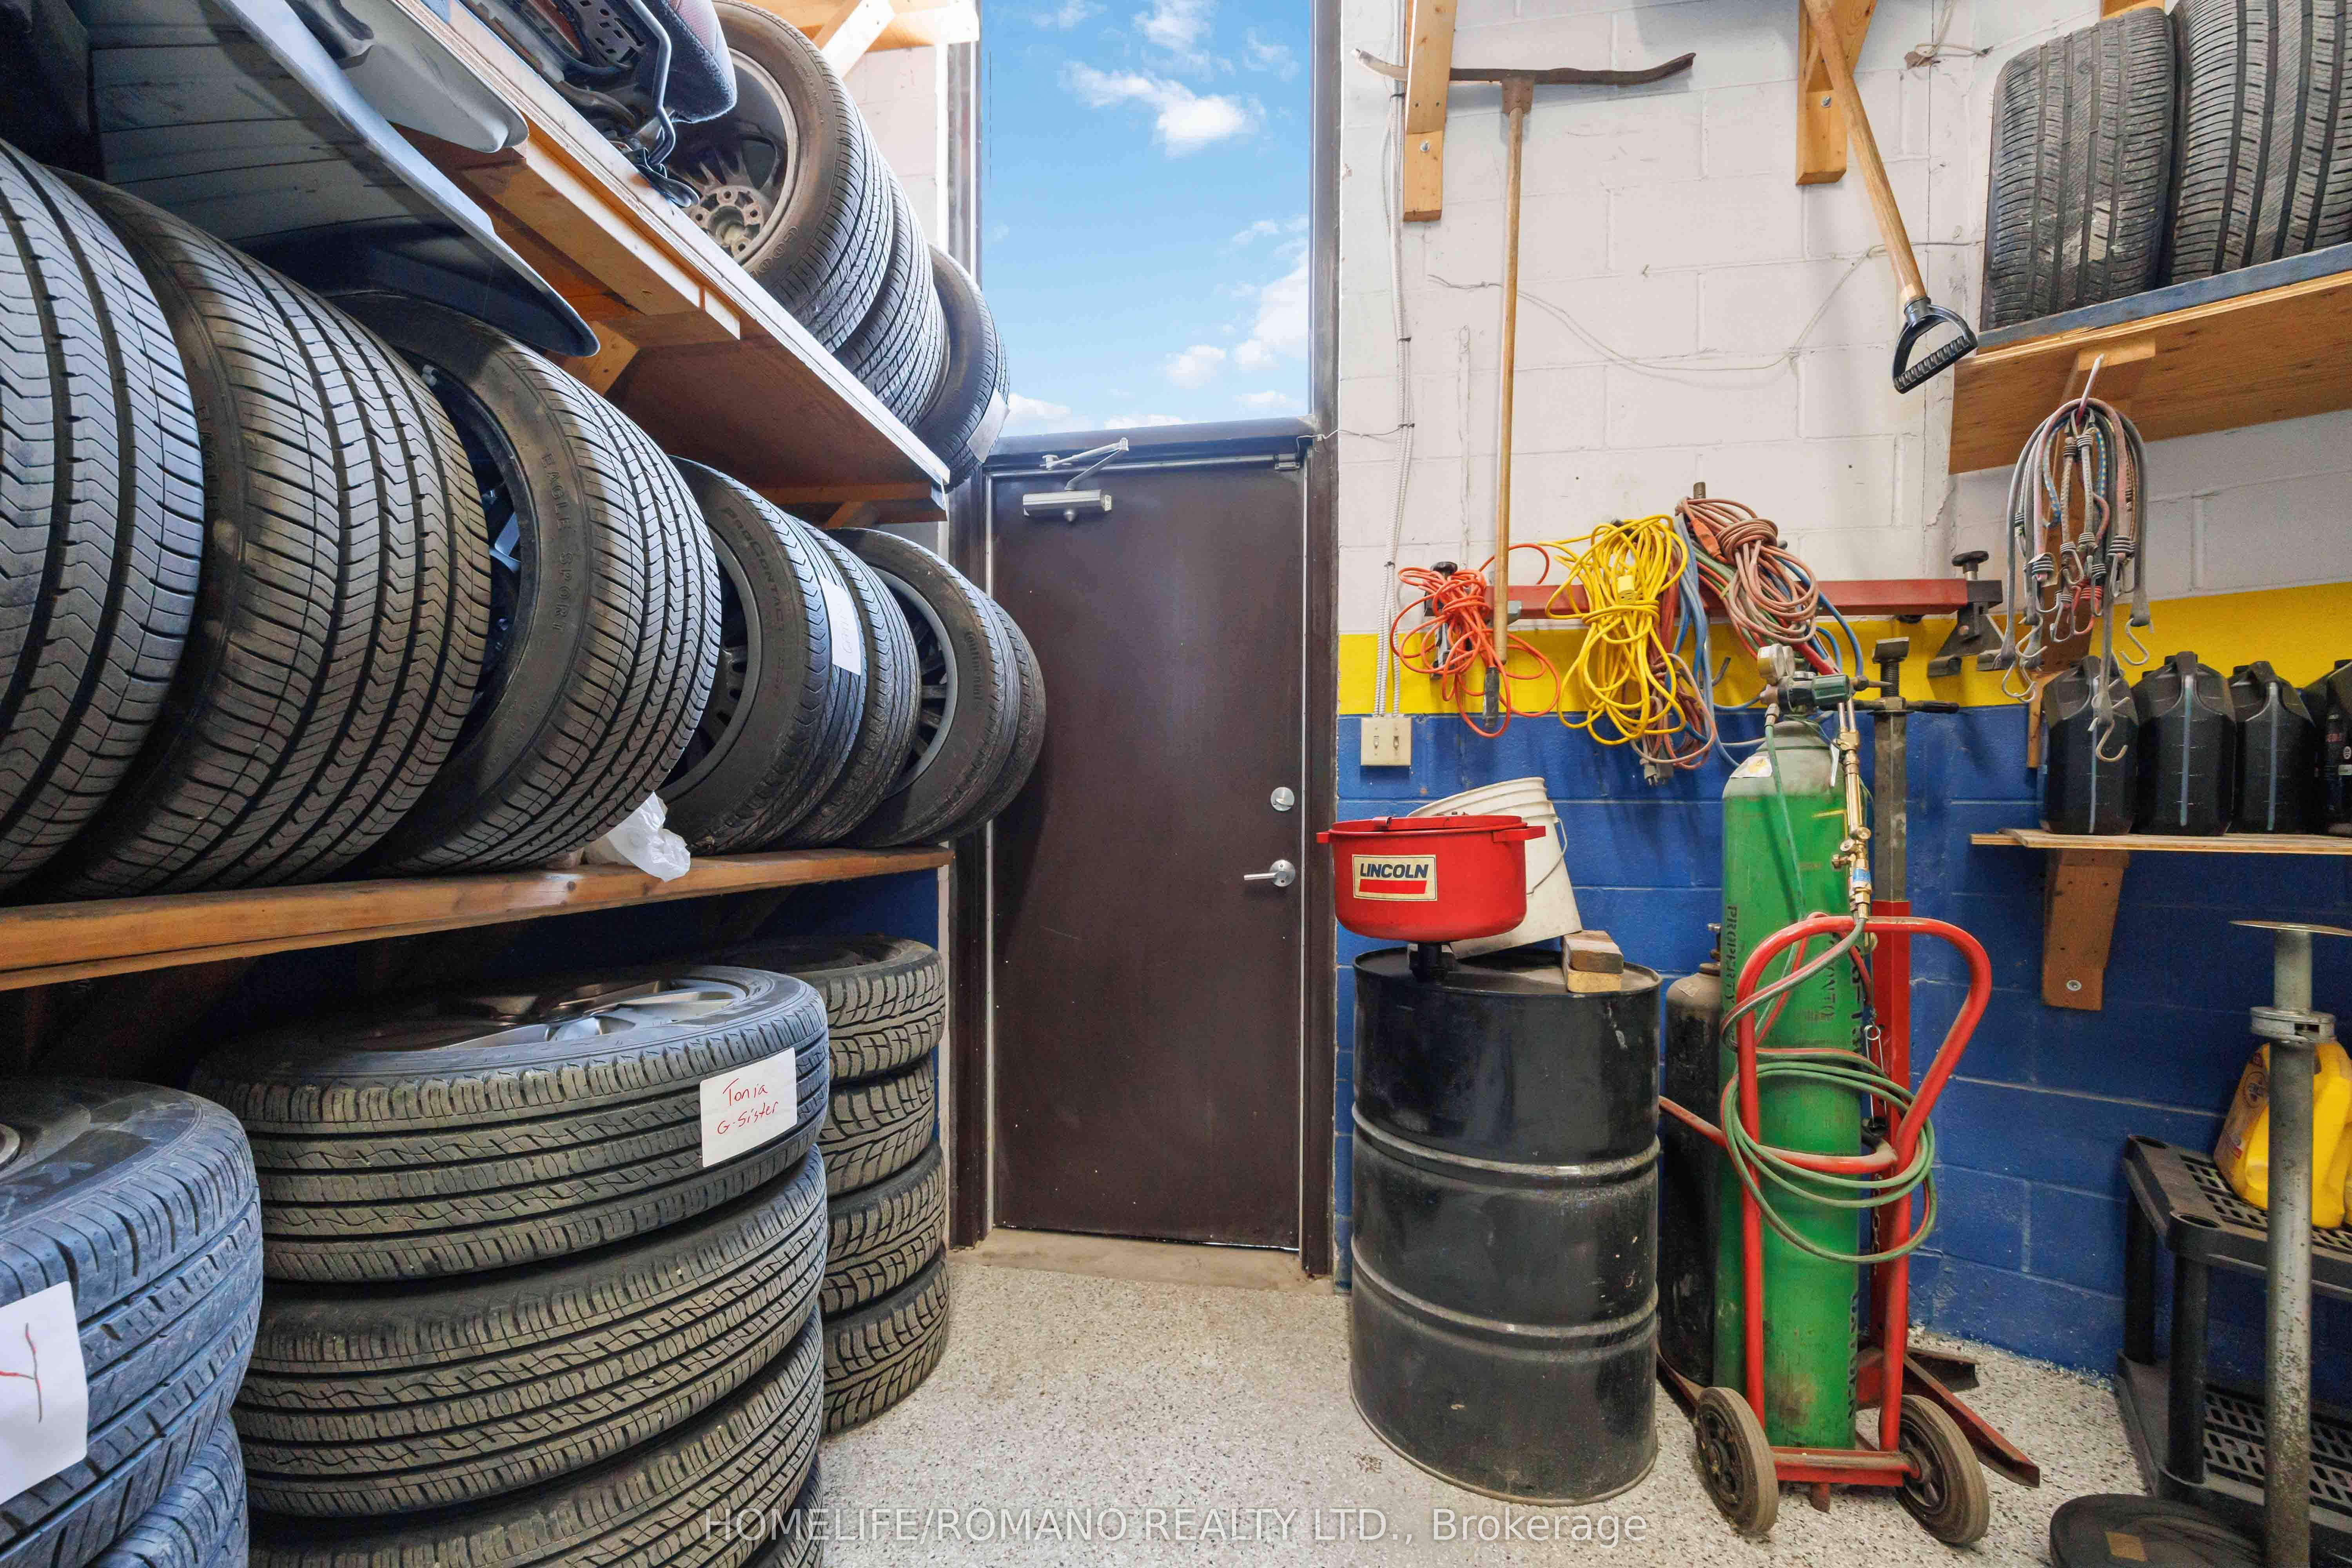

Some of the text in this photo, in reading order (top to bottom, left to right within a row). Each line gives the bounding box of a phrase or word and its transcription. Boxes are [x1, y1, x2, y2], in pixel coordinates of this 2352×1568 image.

[541, 452, 573, 635] EAGLE SPORT
[1360, 863, 1428, 878] LINCOLN
[1725, 905, 1737, 1003] PROPERTY
[723, 1078, 768, 1106] Tonia
